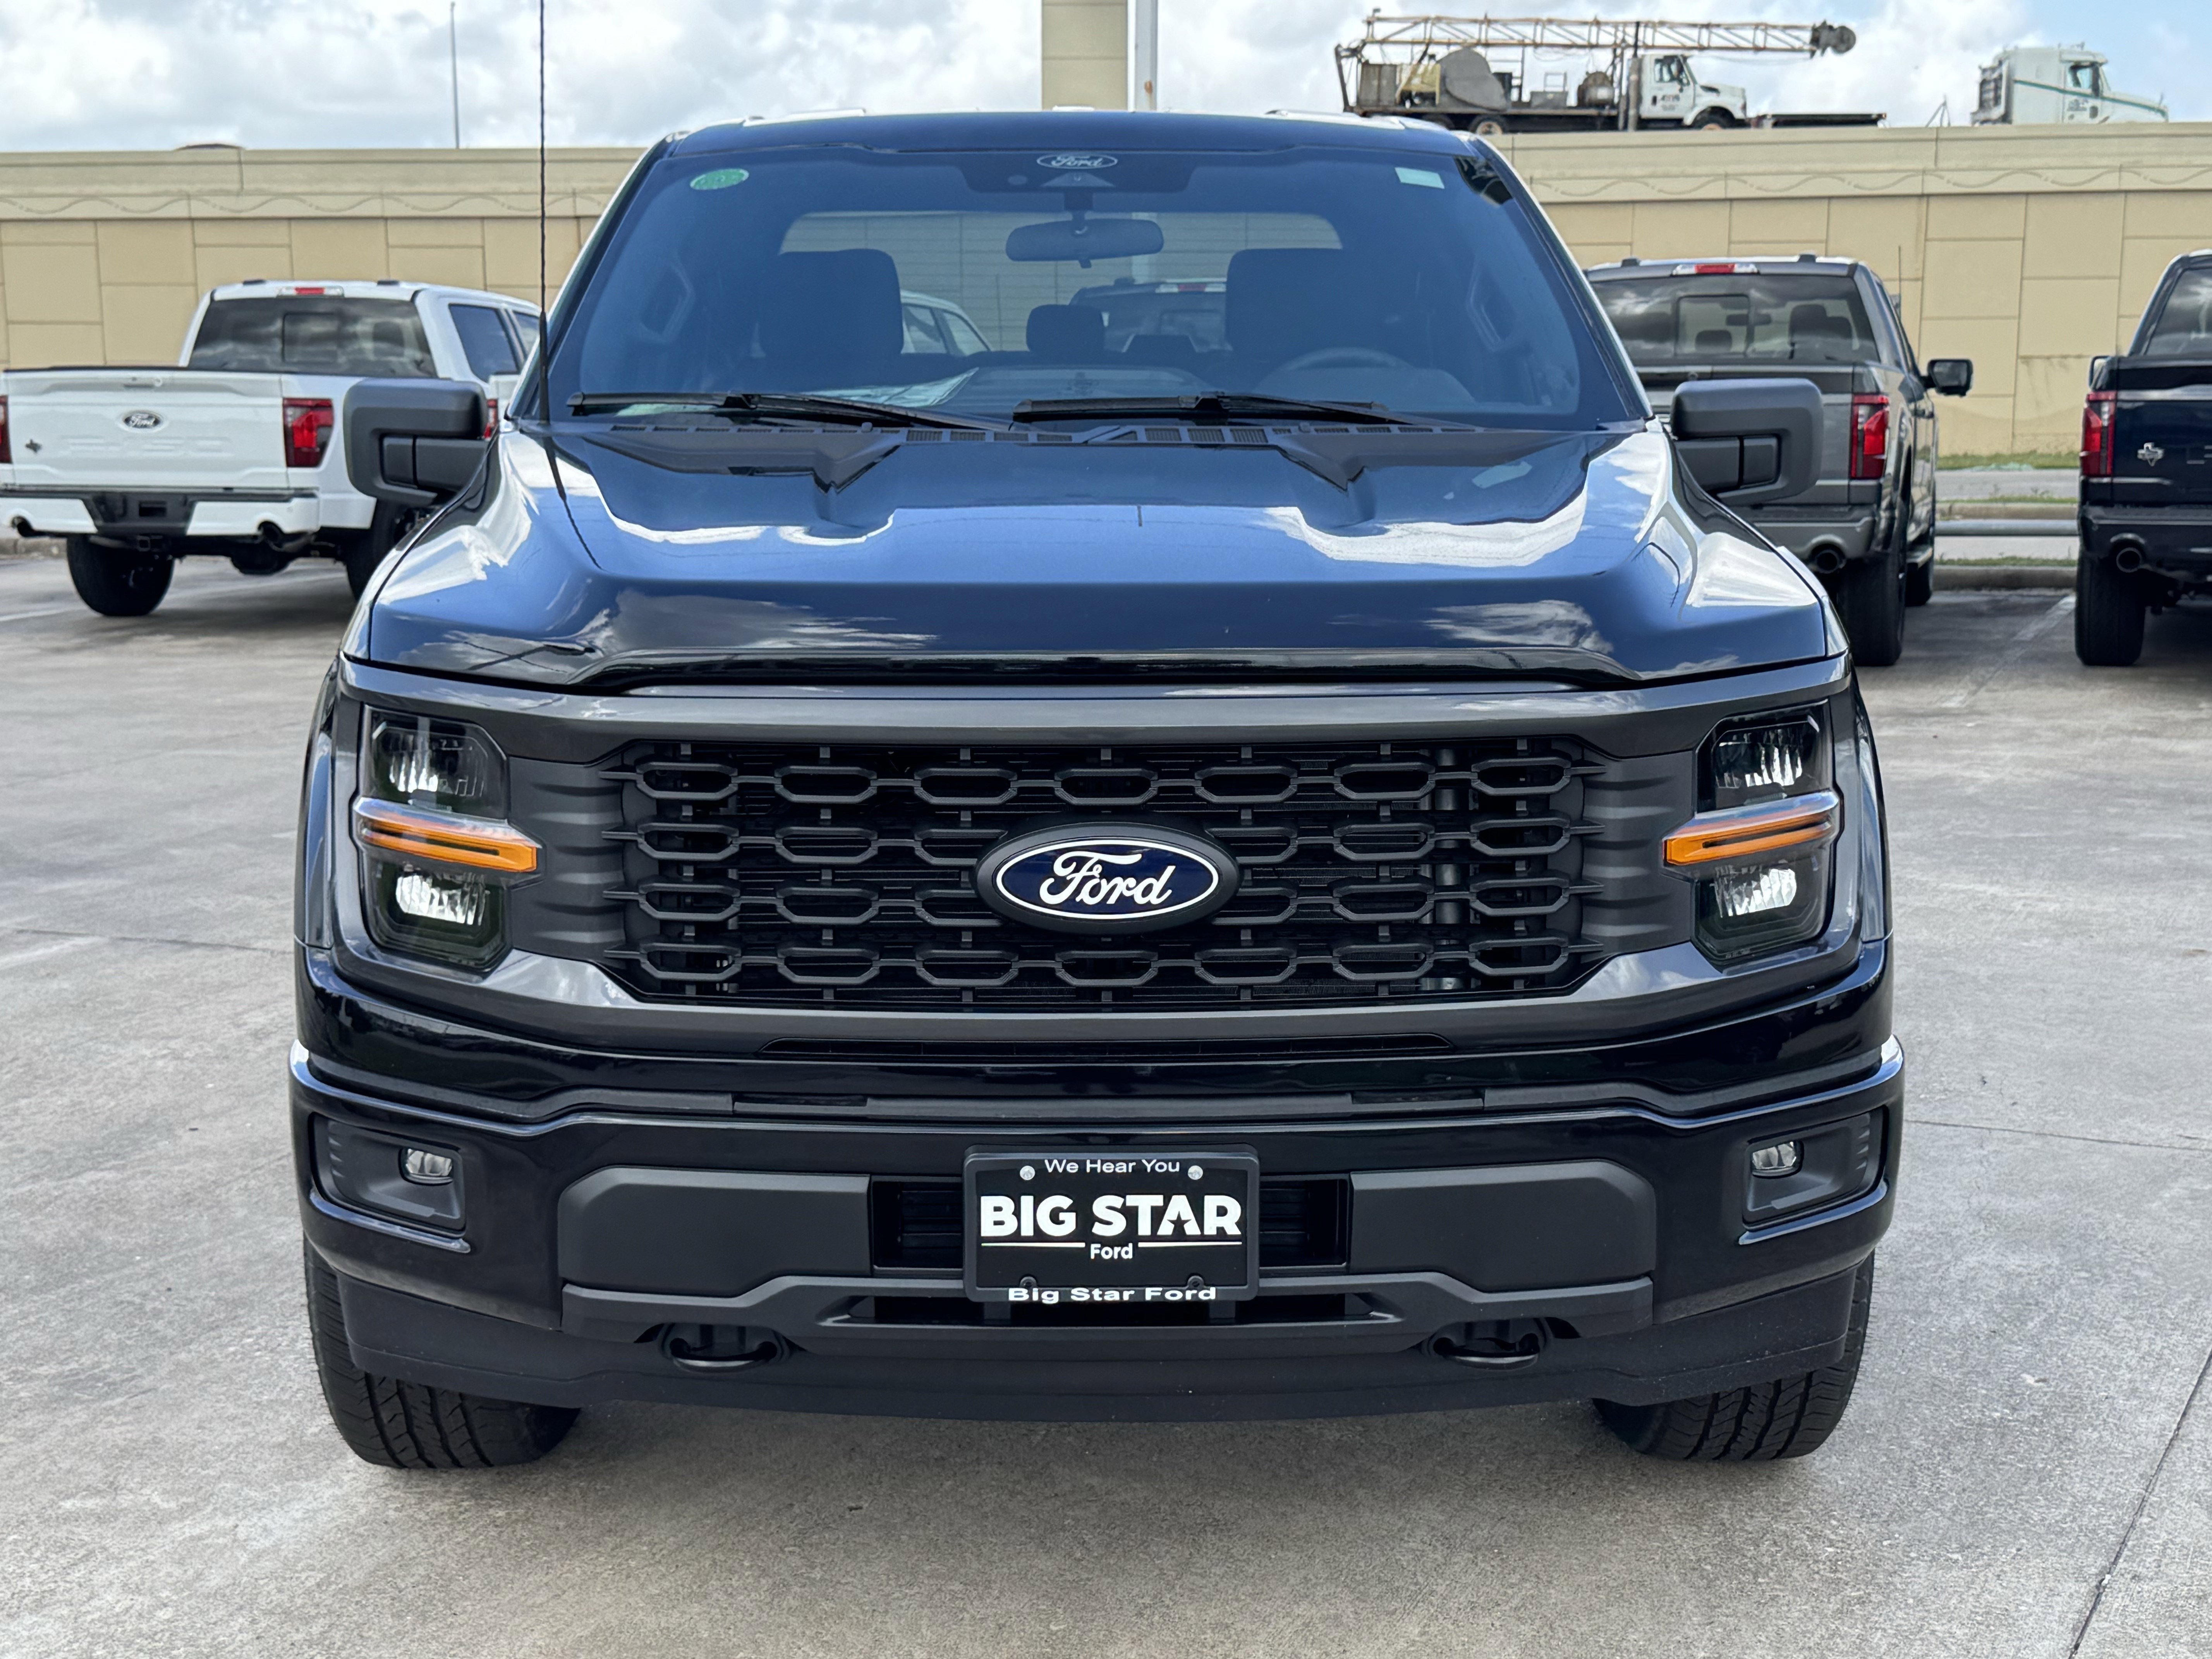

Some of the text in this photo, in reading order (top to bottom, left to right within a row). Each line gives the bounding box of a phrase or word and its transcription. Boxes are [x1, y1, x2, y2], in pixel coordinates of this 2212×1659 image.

[1051, 154, 1103, 167] Ford
[129, 413, 156, 426] Ford
[1039, 851, 1176, 905] Ford
[1044, 1159, 1180, 1173] We Hear You
[981, 1195, 1242, 1237] BIG STAR
[1091, 1243, 1133, 1259] Ford
[1008, 1286, 1216, 1304] Big Star Ford
